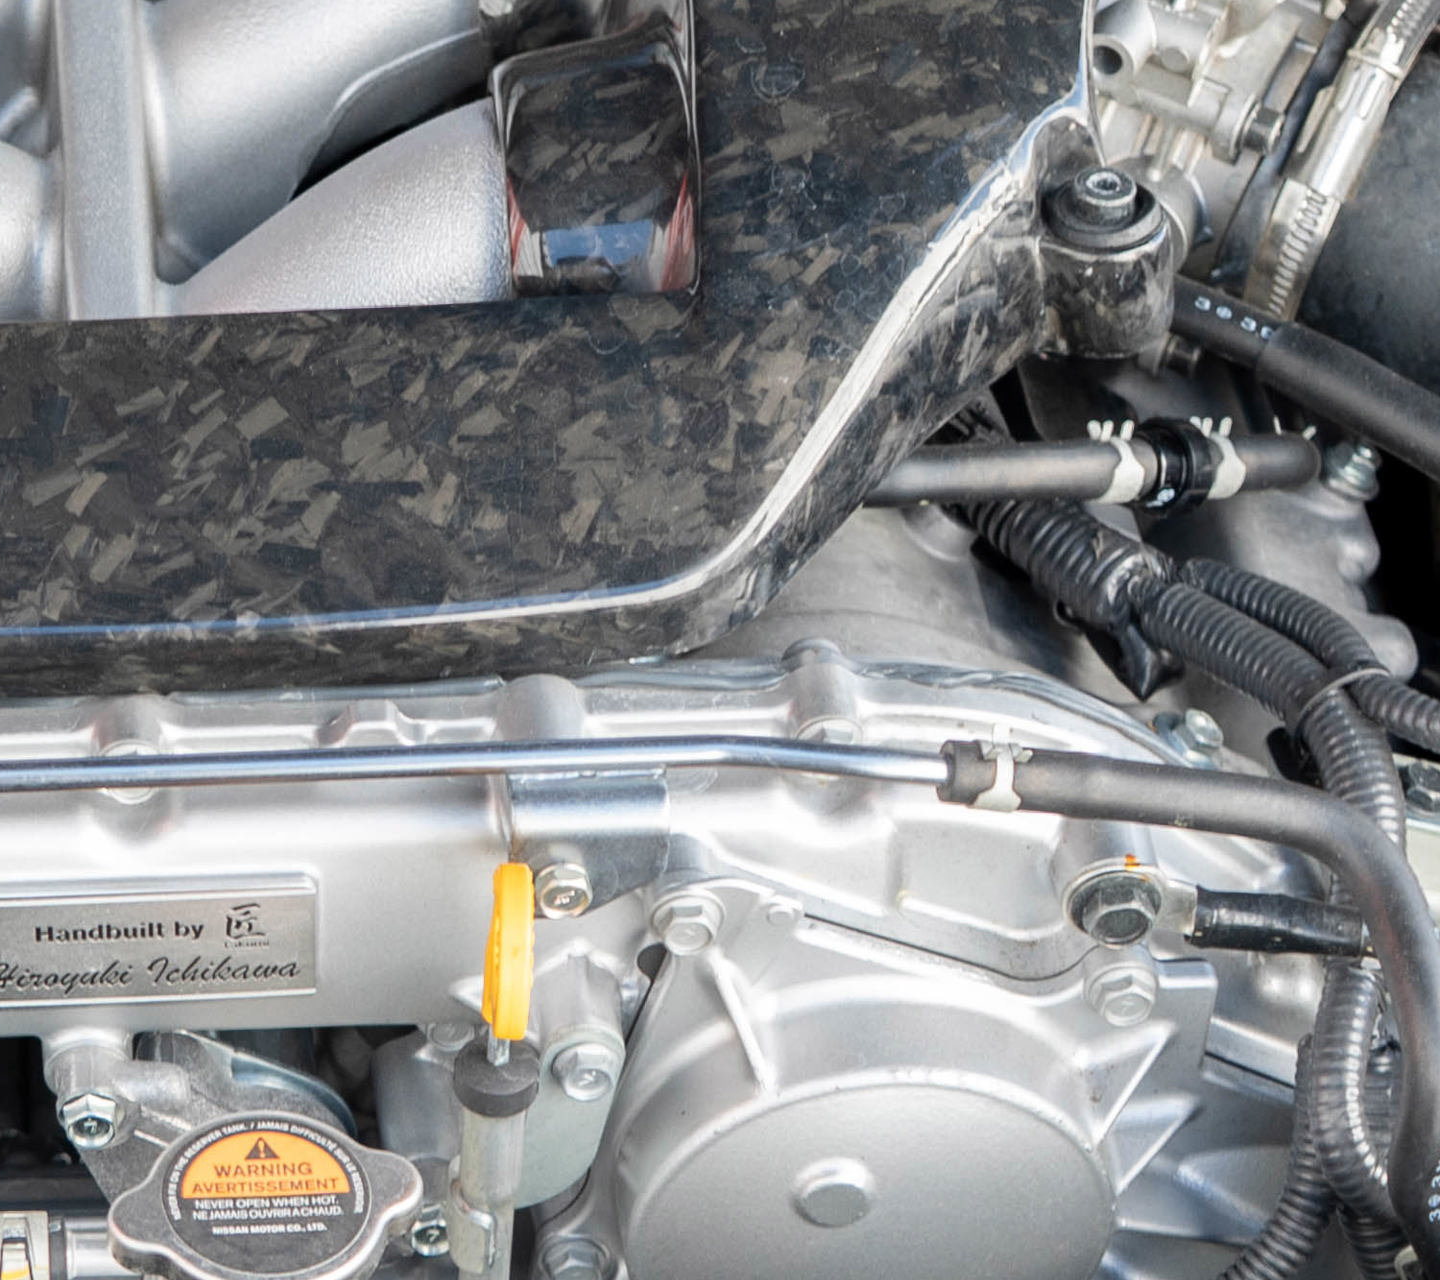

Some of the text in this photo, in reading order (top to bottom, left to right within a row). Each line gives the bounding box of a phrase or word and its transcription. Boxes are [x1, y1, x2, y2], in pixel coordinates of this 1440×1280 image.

[35, 921, 205, 943] Handbuilt by
[148, 955, 301, 985] Ichikawa
[257, 1121, 289, 1132] JAMAIS
[214, 1161, 313, 1178] WARNING
[192, 1178, 340, 1194] AVERTISSEMENT
[195, 1196, 339, 1209] NEVER OPEN WHEN HOT.
[209, 1209, 248, 1220] JAMAIS
[248, 1208, 289, 1219] OUVRIR
[301, 1206, 344, 1217] CHAUD.
[212, 1225, 249, 1235] NISSAN
[250, 1224, 285, 1234] MOTOR
[307, 1223, 327, 1232] LTD.
